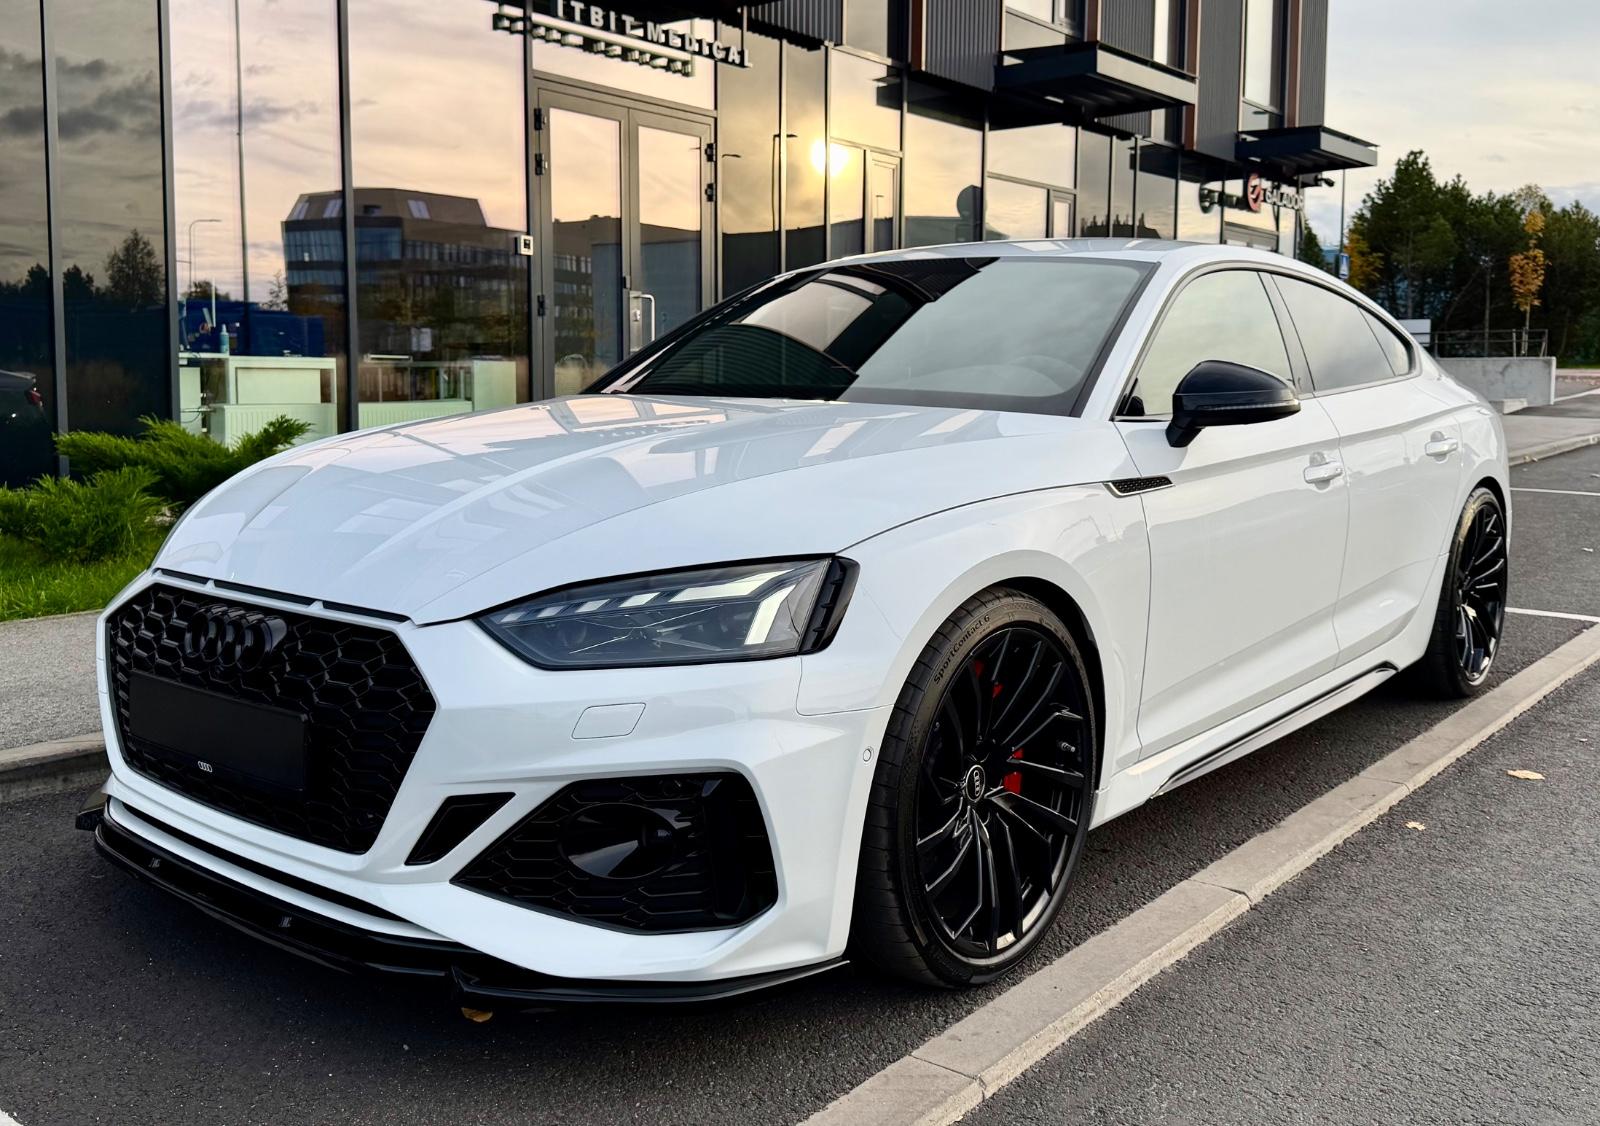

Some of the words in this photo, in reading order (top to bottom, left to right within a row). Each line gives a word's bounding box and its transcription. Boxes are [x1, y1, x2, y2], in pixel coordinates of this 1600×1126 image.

[646, 20, 753, 67] MEDICAL
[933, 619, 983, 685] SportContact
[983, 613, 990, 623] 6
